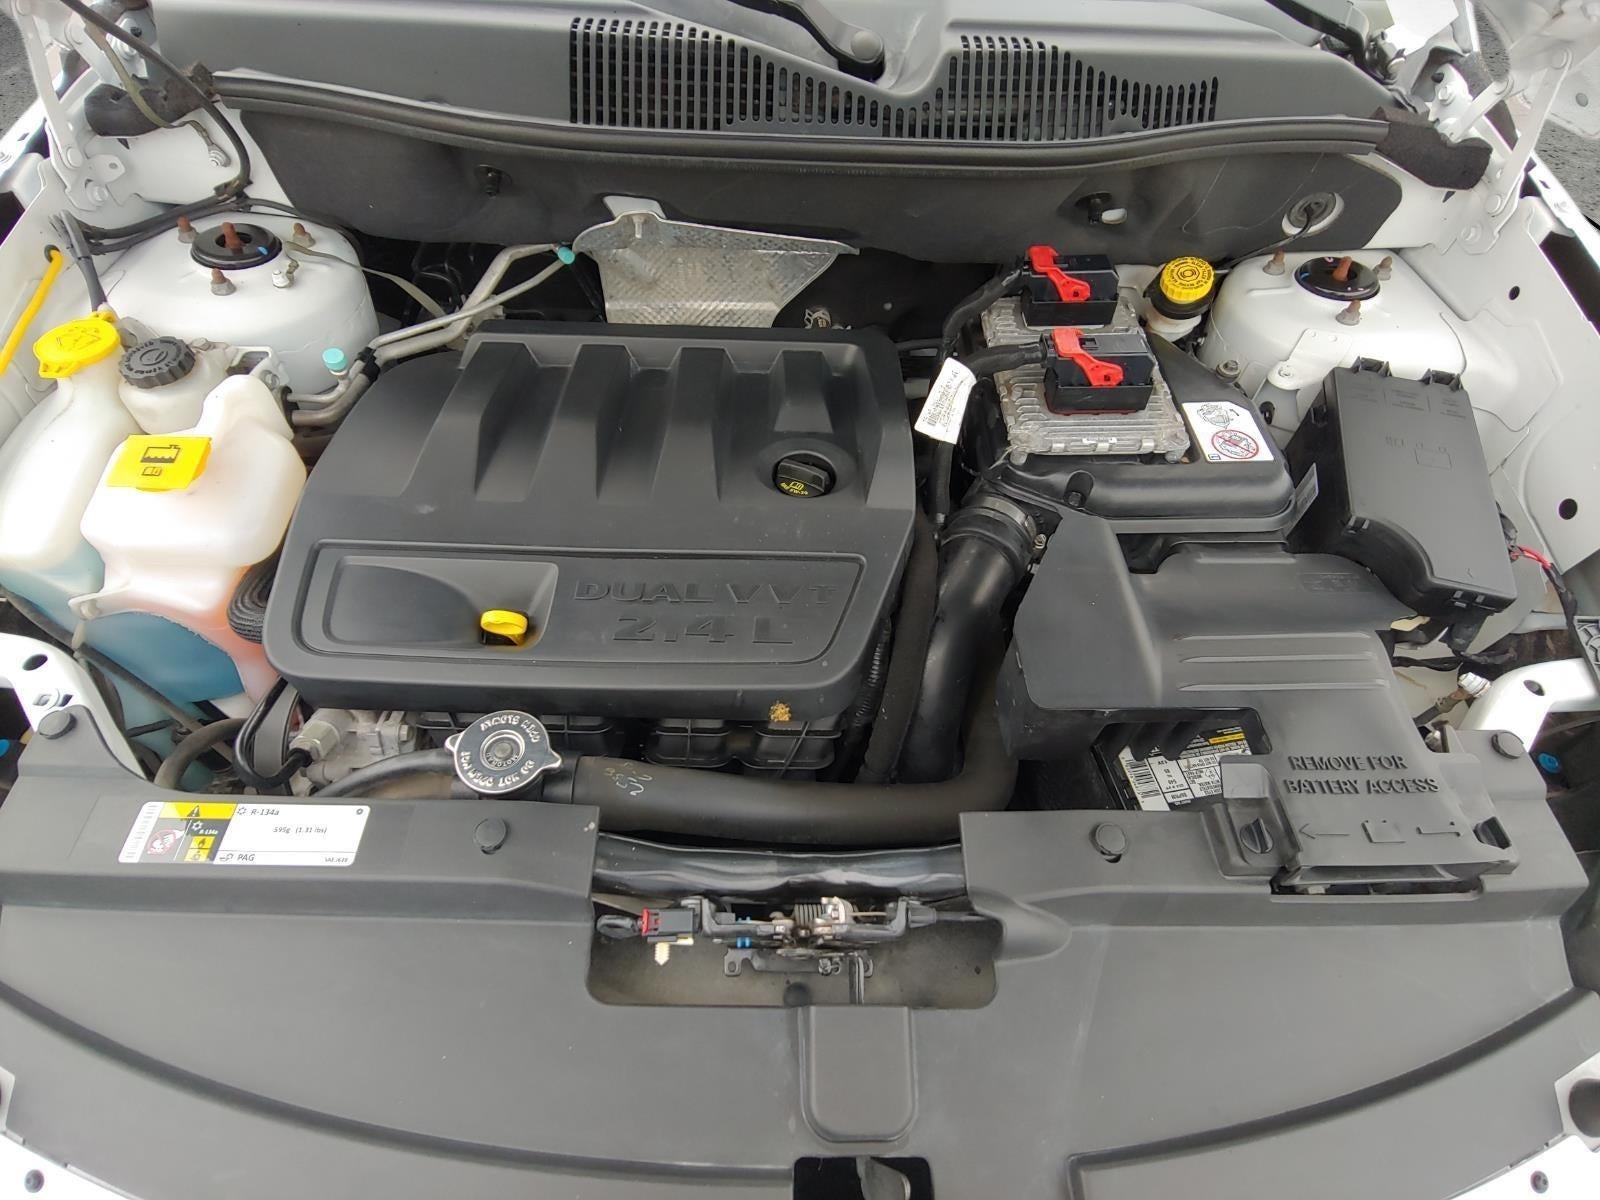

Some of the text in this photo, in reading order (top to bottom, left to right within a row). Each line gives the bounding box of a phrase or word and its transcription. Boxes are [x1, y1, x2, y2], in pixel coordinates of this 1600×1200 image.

[574, 580, 838, 604] DUAL VVT
[520, 719, 541, 743] OPEN
[520, 760, 536, 774] DO
[1287, 755, 1408, 771] REMOVE FOR
[467, 768, 494, 787] OPEN
[498, 772, 520, 787] NOT
[1283, 778, 1440, 794] BATTERY ACCESS
[250, 808, 280, 816] R-134a
[273, 826, 291, 834] 595g
[237, 853, 256, 862] PAG
